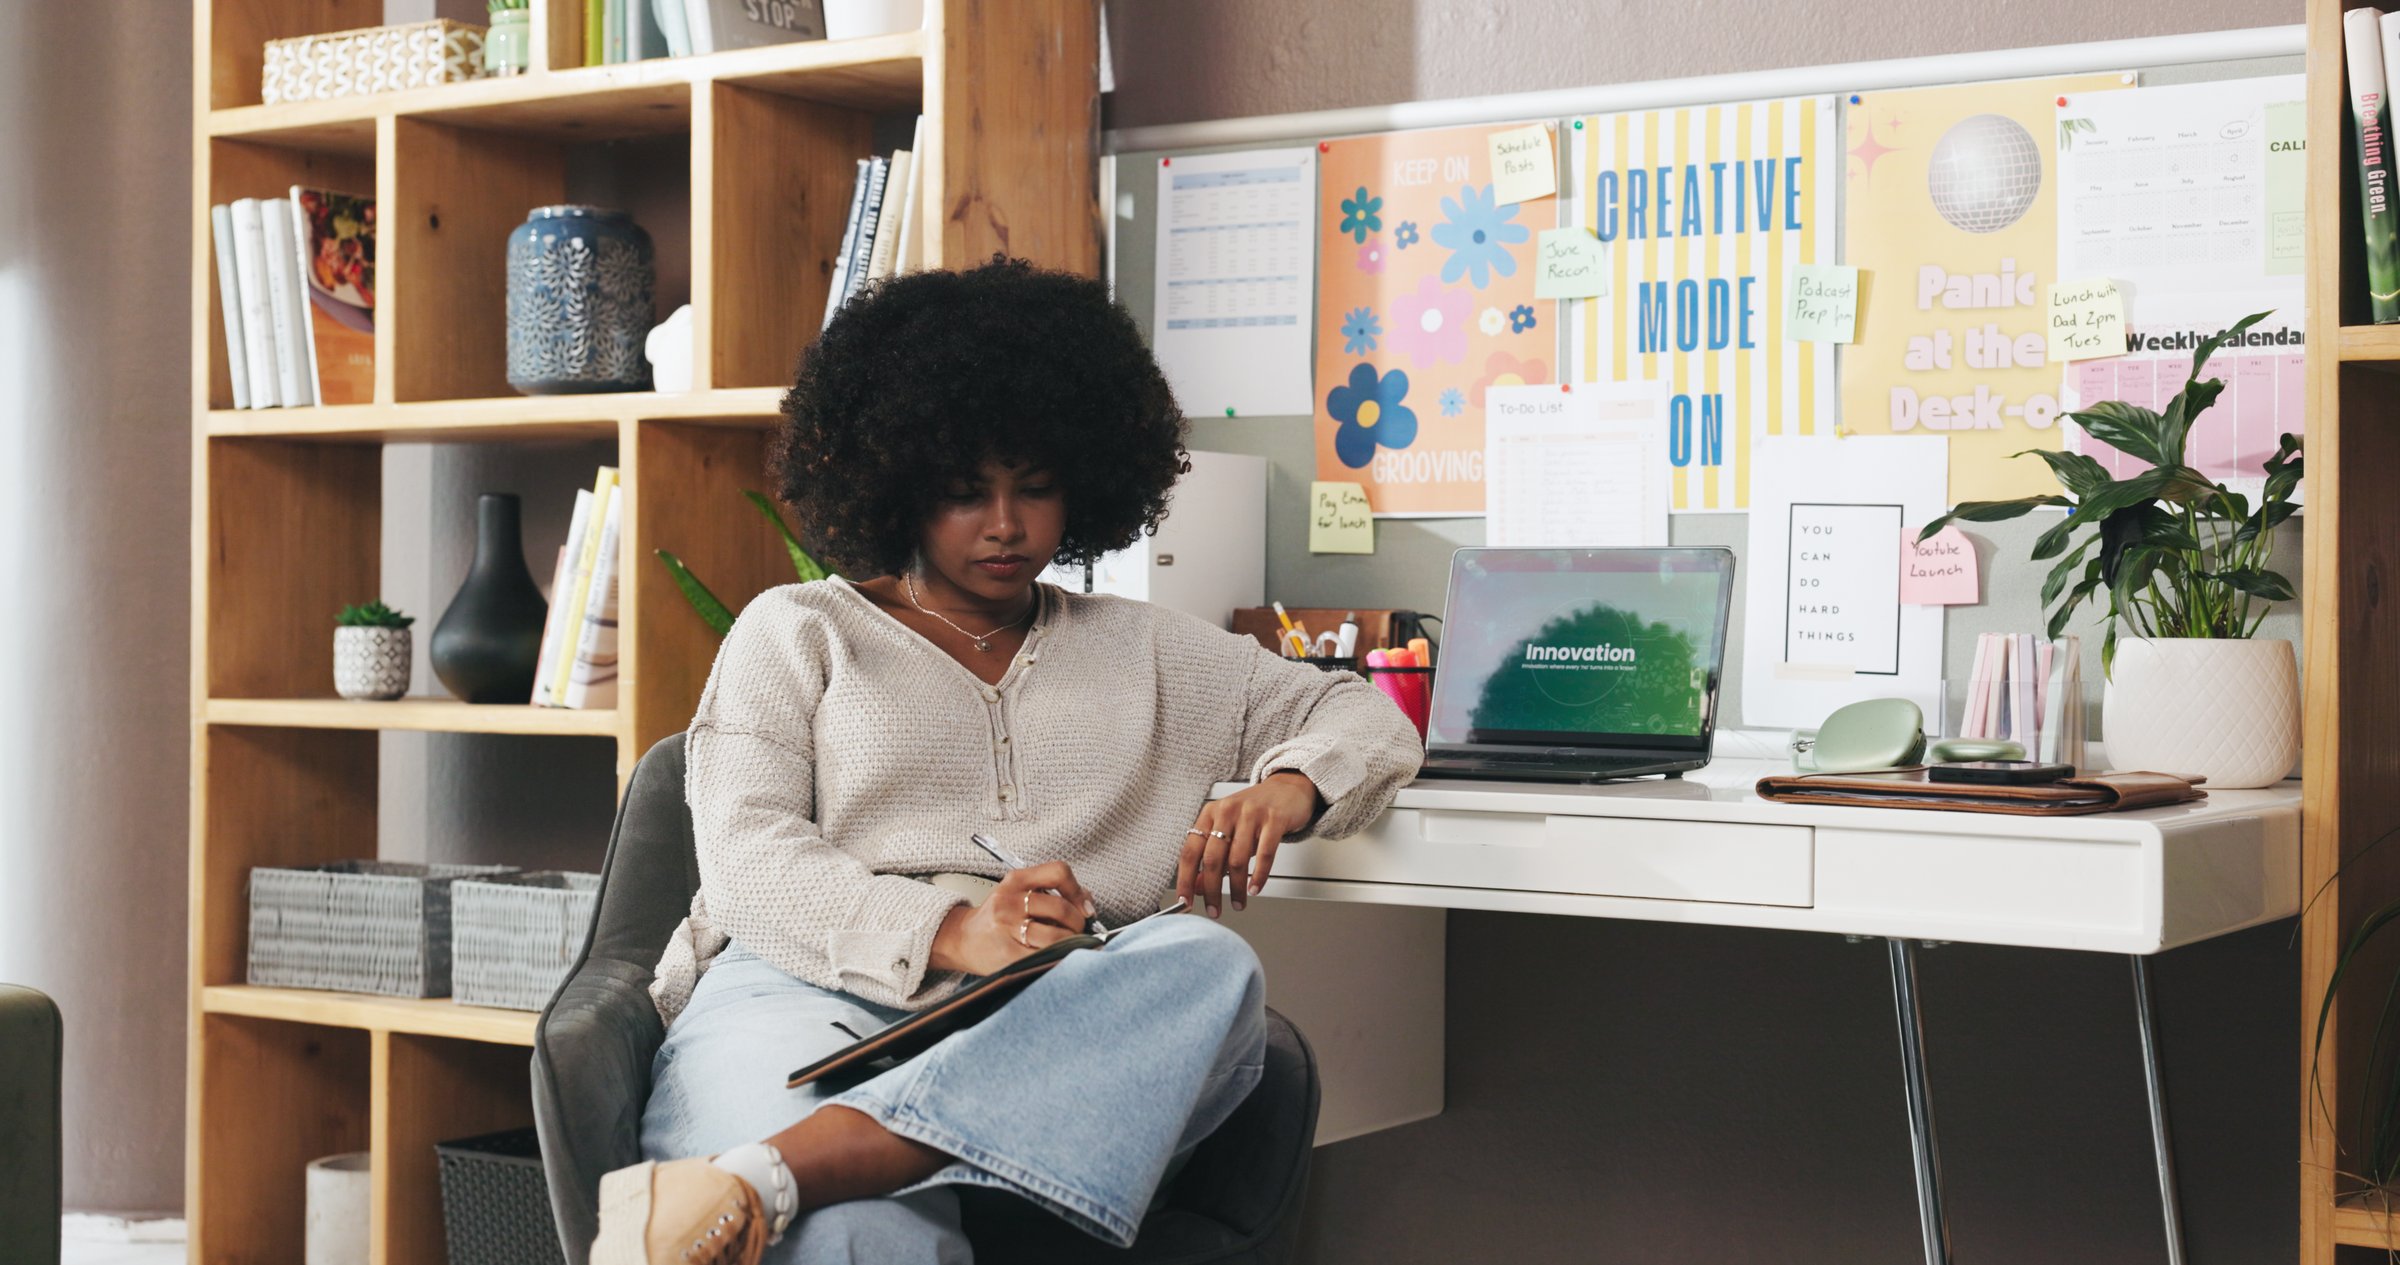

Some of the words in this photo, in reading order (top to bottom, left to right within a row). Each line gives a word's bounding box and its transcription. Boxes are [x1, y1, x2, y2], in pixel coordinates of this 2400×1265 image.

[745, 0, 795, 29] STOP
[2360, 92, 2384, 167] Breathing
[1392, 158, 1438, 186] KEEP
[1443, 155, 1470, 182] ON
[1504, 158, 1535, 175] Posts
[1597, 156, 1803, 242] CREATIVE
[1799, 276, 1851, 298] Podcast
[1917, 257, 2036, 310] Panic
[2053, 289, 2094, 307] Lunch
[1638, 276, 1756, 354] MODE
[1796, 299, 1828, 325] Prep
[2053, 313, 2077, 328] Dad
[2086, 311, 2116, 330] 2pm
[1905, 328, 1953, 371] at
[1965, 323, 2046, 369] the
[2063, 333, 2102, 349] Tues
[1499, 402, 1536, 415] To-Do
[1539, 401, 1564, 414] List
[1669, 393, 1723, 468] ON
[1319, 492, 1337, 517] Pay
[1340, 516, 1366, 530] lunch
[1802, 526, 1833, 535] YOU
[1801, 552, 1831, 561] CAN
[1910, 541, 1960, 558] Youtube
[1910, 564, 1963, 578] Launch
[1800, 578, 1820, 587] DO
[1799, 605, 1840, 615] HARD
[1798, 631, 1855, 642] THINGS
[1526, 643, 1636, 662] Innovation
